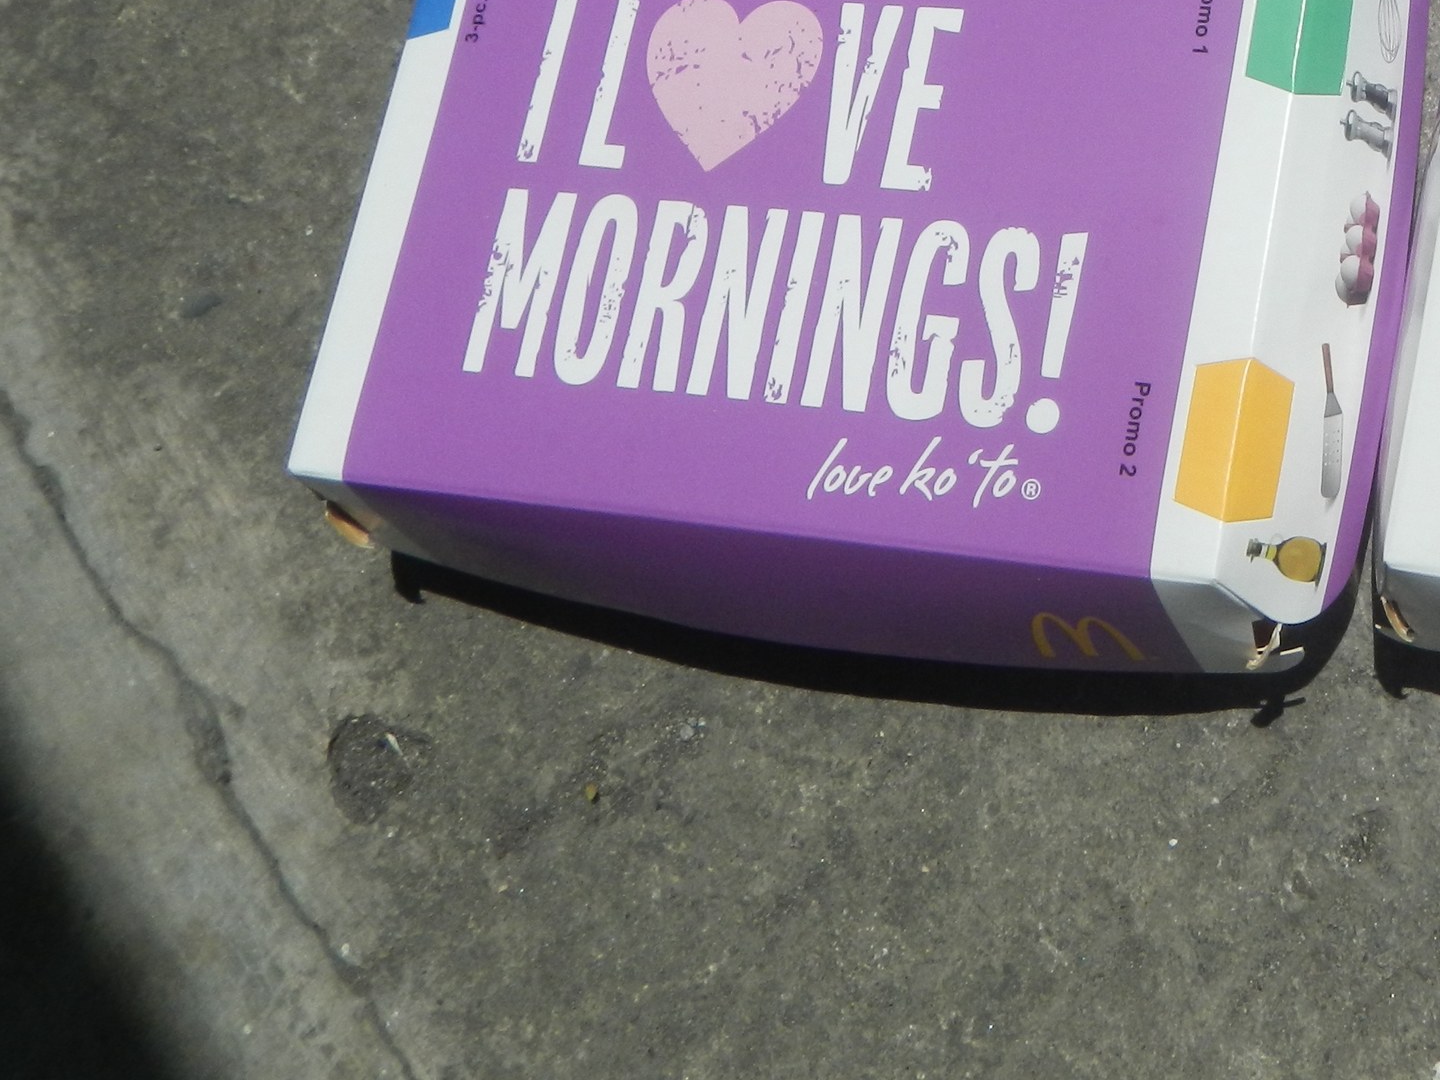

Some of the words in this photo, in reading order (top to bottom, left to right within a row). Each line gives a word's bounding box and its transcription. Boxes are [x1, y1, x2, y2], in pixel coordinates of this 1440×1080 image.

[464, 0, 487, 43] 3-pc.
[463, 189, 1089, 434] MORNINGS!
[1123, 381, 1152, 457] Promo
[807, 438, 892, 499] love
[899, 437, 957, 500] ko
[1118, 463, 1137, 478] 2
